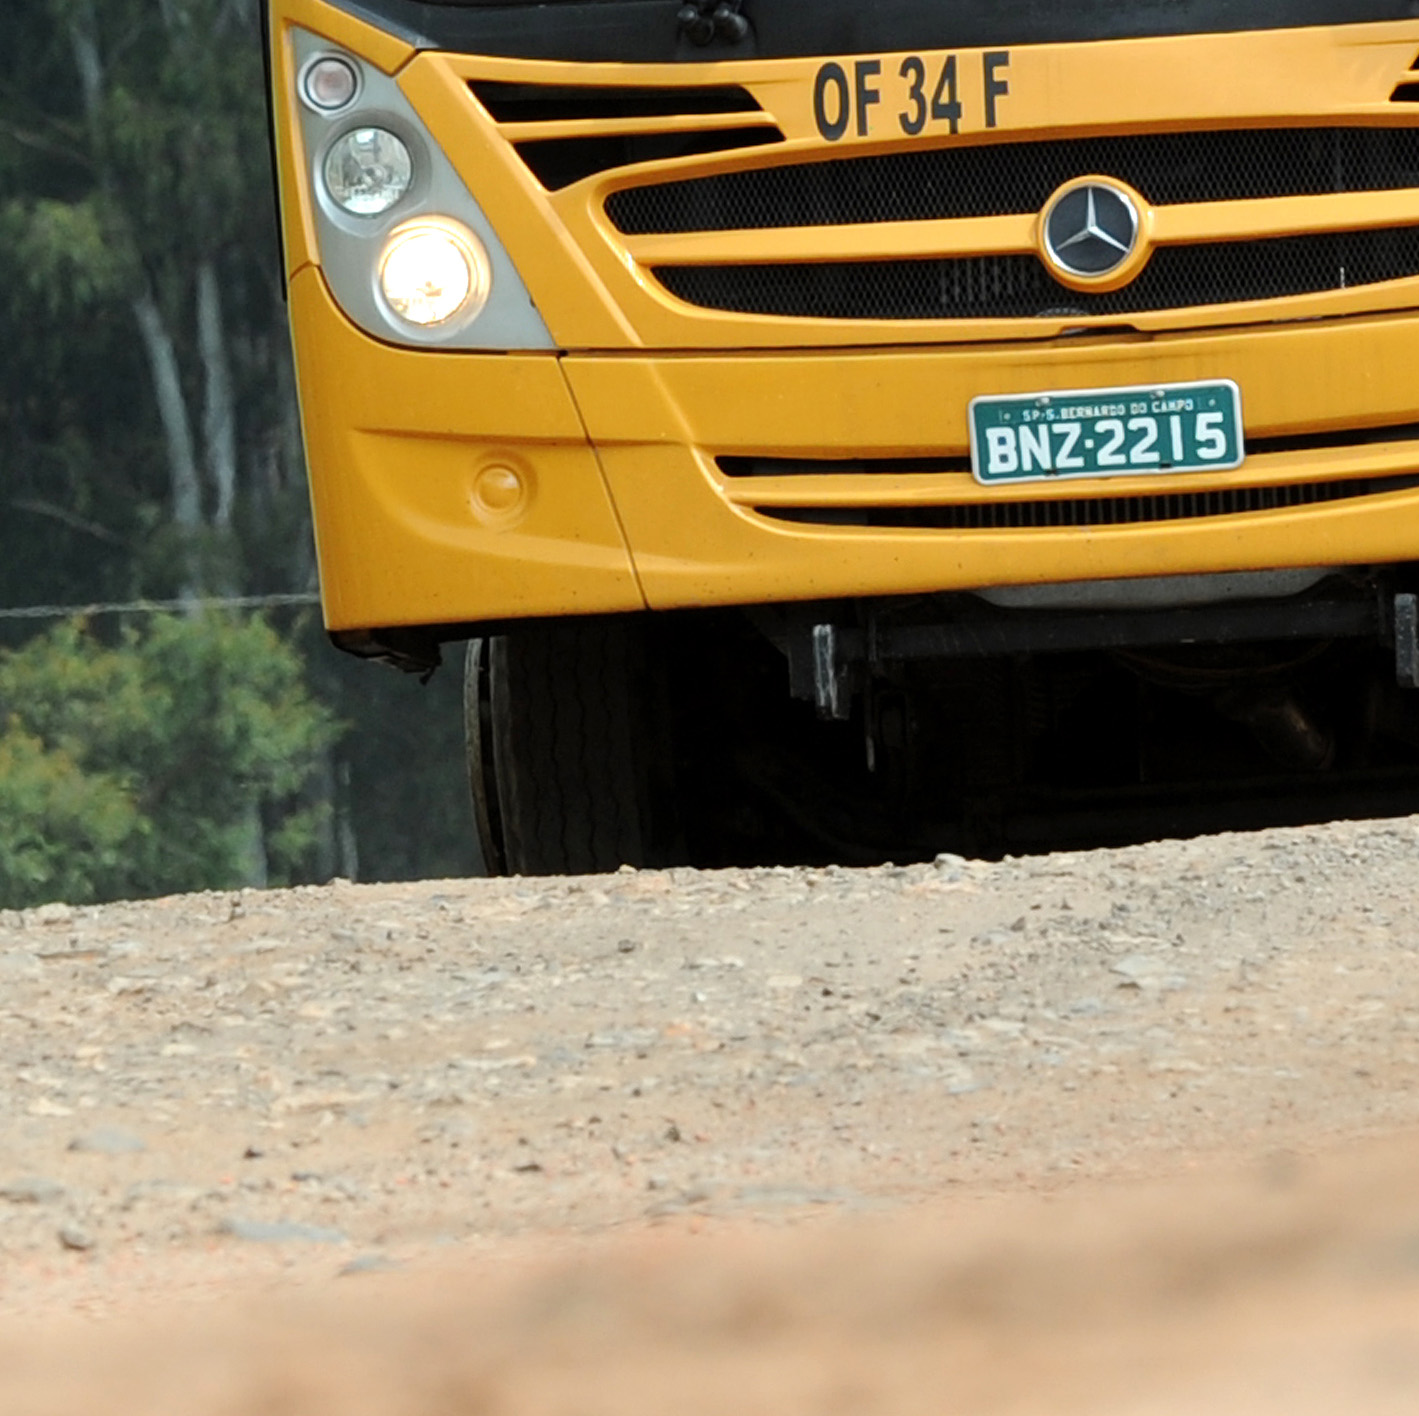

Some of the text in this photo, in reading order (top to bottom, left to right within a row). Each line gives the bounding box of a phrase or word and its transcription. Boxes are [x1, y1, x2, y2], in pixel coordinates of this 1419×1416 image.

[813, 50, 1010, 142] OF 34 F
[1130, 401, 1148, 414] DO
[1152, 398, 1194, 414] CAMPO
